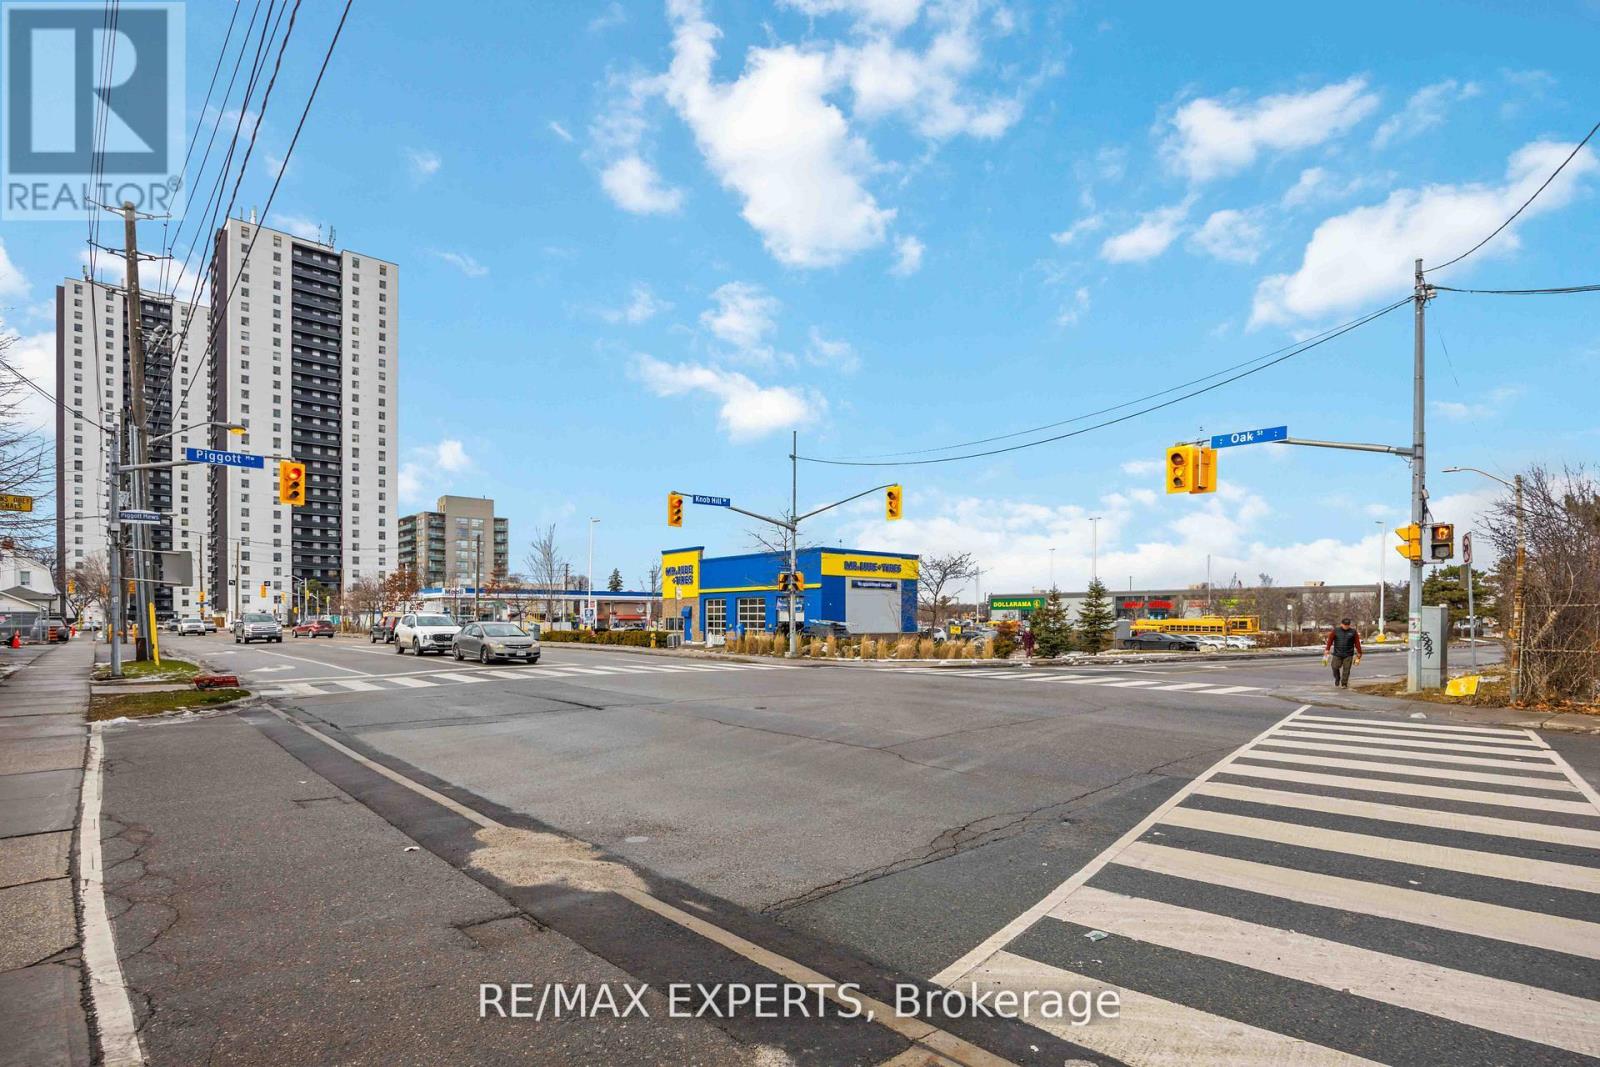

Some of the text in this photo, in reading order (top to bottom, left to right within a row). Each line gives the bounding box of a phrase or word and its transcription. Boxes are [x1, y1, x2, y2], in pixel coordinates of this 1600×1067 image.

[1231, 431, 1254, 443] Oak
[196, 450, 242, 463] Piggott
[695, 495, 710, 504] Knob
[711, 497, 722, 505] Hill
